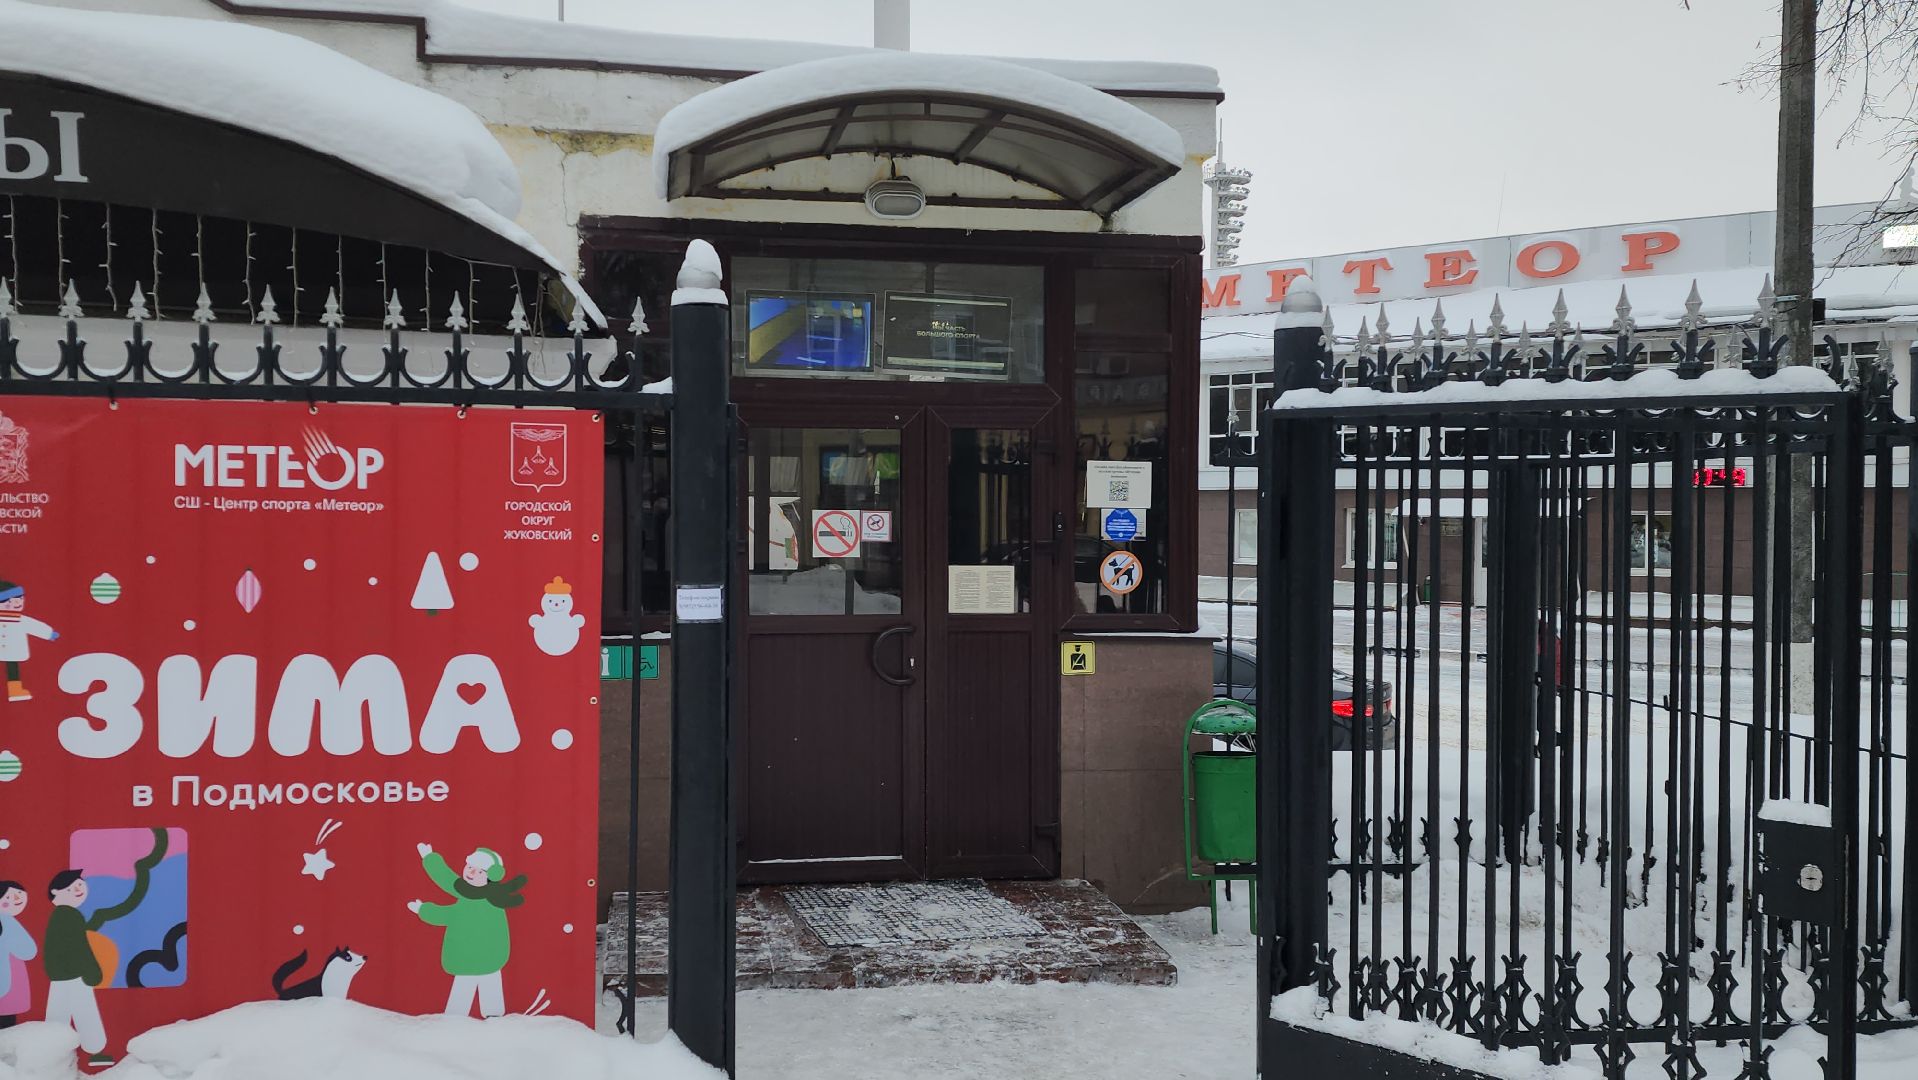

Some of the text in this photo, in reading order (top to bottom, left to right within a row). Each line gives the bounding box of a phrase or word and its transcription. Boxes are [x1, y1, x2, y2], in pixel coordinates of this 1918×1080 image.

[1202, 230, 1681, 309] МЕТЕОР
[174, 442, 385, 491] МЕТЕОР
[174, 495, 200, 509] СШ
[213, 497, 258, 511] Центр
[261, 500, 311, 513] спорта
[314, 499, 385, 514] «Метеор»
[504, 500, 572, 513] ГОРОДСКОЙ
[503, 528, 572, 540] ЖУКОВСКИЙ
[521, 515, 556, 526] ОКРУГ
[57, 652, 521, 758] ЗИМА
[132, 775, 450, 810] в Подмосковье
